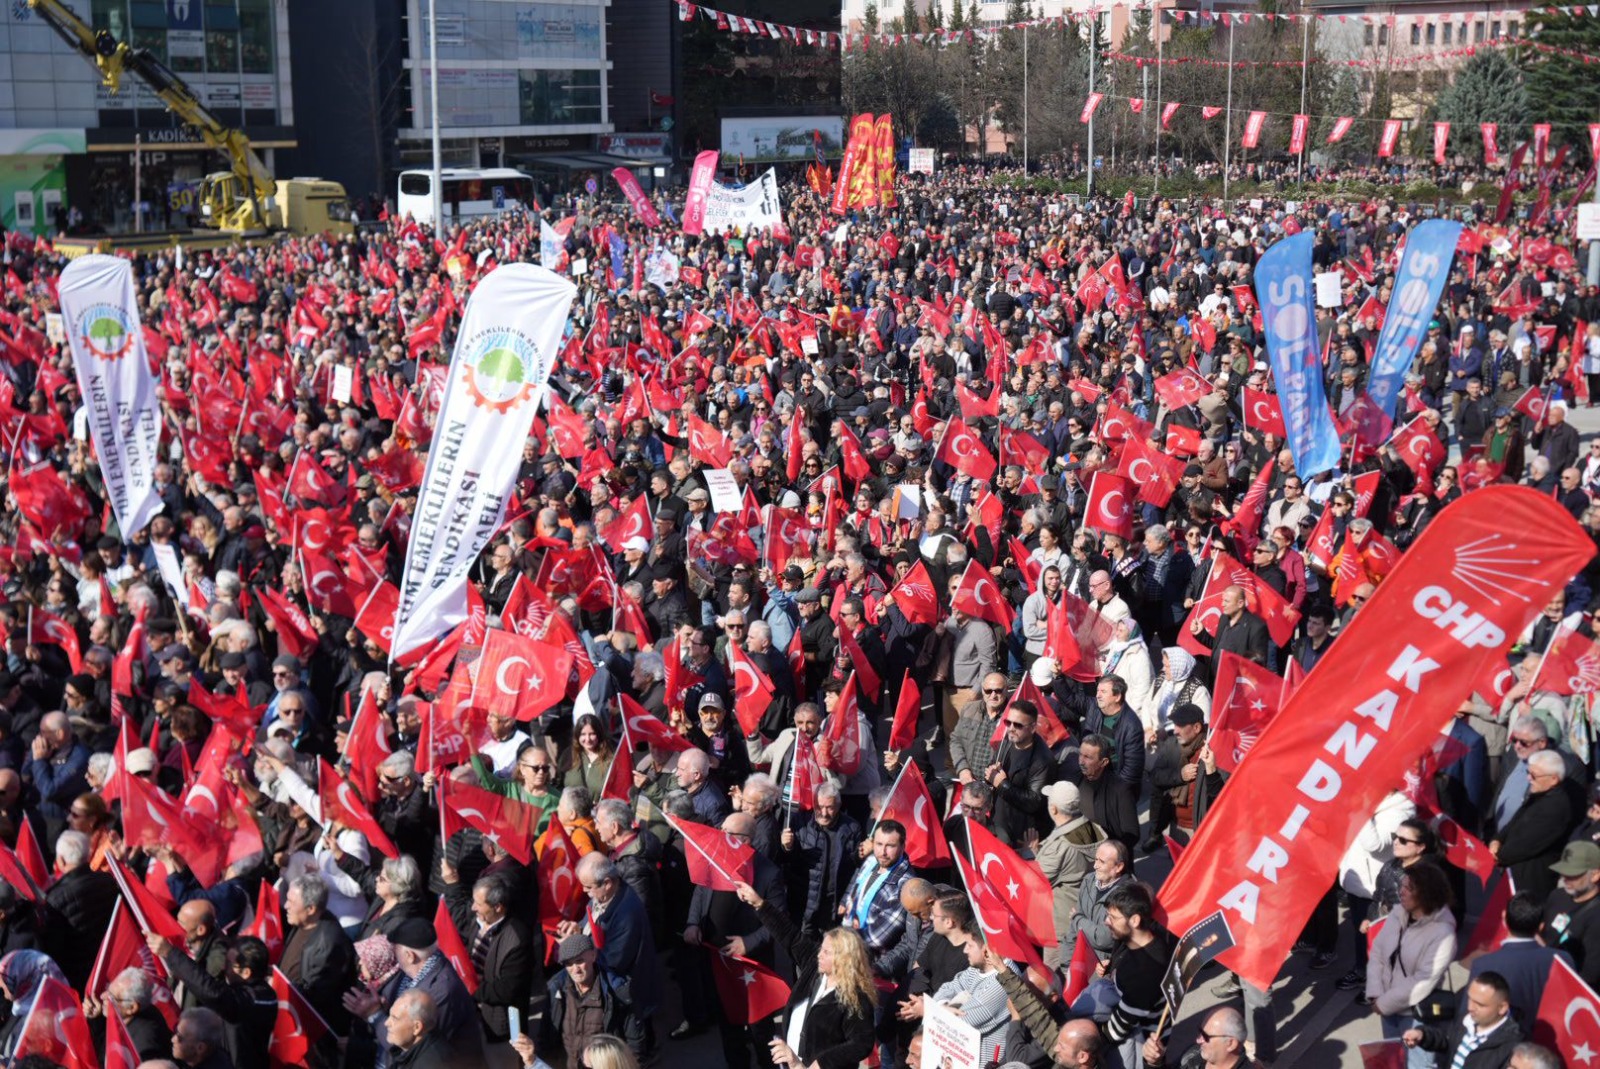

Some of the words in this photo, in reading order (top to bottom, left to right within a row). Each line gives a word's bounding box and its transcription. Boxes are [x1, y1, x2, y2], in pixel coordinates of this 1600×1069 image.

[545, 138, 569, 147] STUDIO
[495, 188, 503, 199] P
[691, 203, 701, 222] CHP
[1268, 274, 1310, 372] SOL
[1387, 249, 1440, 339] SOL
[411, 419, 466, 574] EMEKLİLERİN
[431, 468, 481, 590] SENDİKASI
[1412, 584, 1506, 649] CHP
[704, 693, 714, 703] 61
[1217, 643, 1441, 926] KANDIRA
